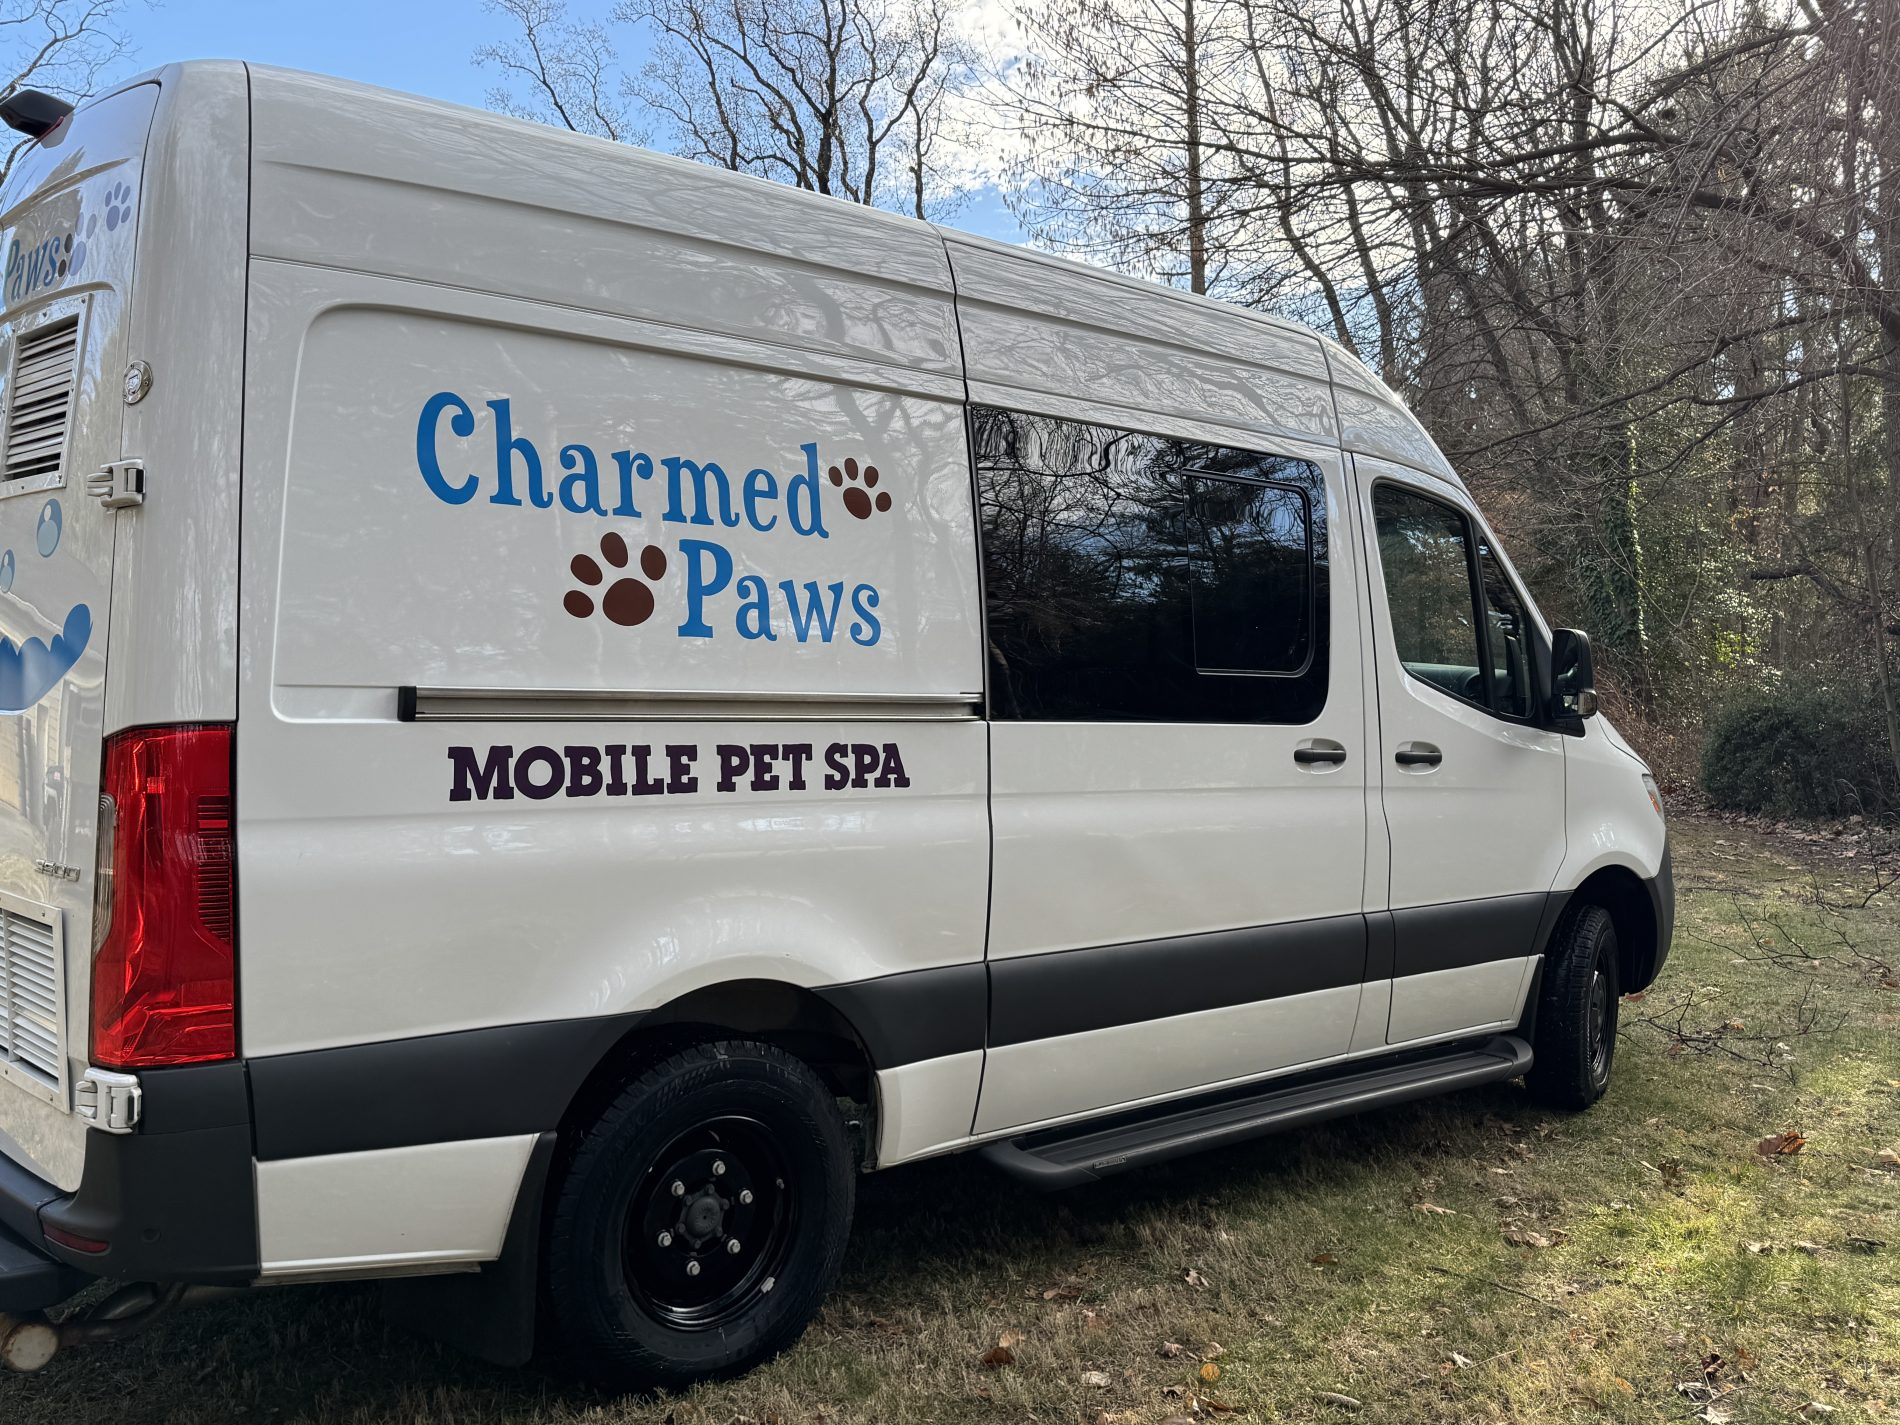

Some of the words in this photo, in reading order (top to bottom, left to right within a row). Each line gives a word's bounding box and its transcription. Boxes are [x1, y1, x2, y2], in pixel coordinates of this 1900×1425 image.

[3, 236, 61, 303] Paws
[417, 392, 829, 539] Charmed
[678, 538, 881, 646] Paws
[448, 744, 699, 802] MOBILE
[717, 743, 812, 793] PET
[825, 742, 911, 791] SPA
